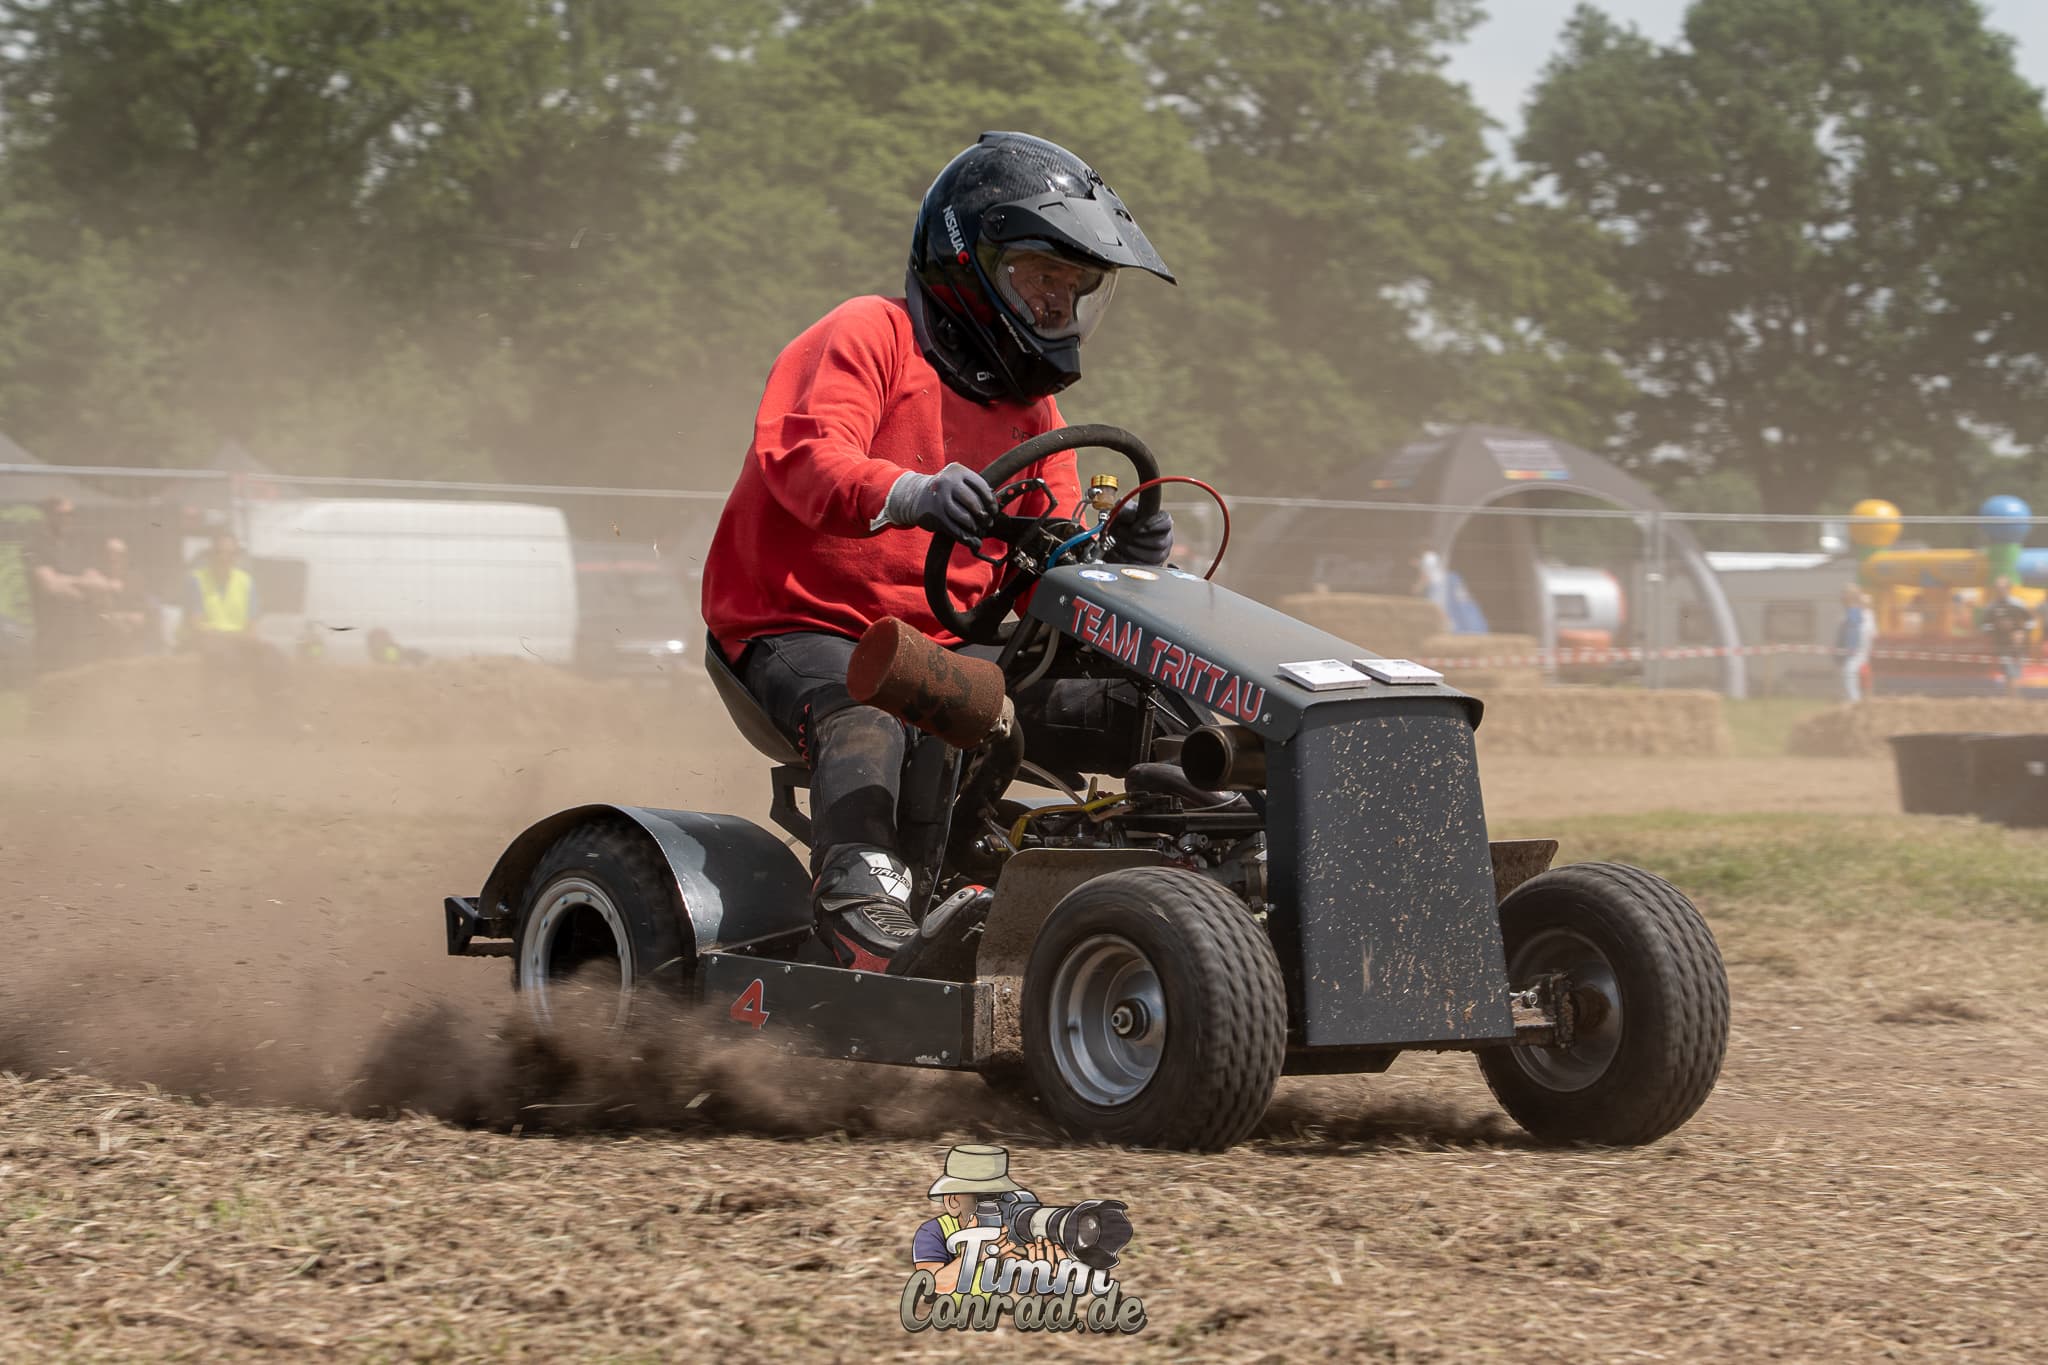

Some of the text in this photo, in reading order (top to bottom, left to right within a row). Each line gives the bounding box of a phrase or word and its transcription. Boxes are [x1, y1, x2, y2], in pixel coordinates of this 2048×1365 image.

[943, 204, 965, 255] NISHUA
[1071, 595, 1267, 723] TEAM TRITTAU
[730, 978, 770, 1031] 4
